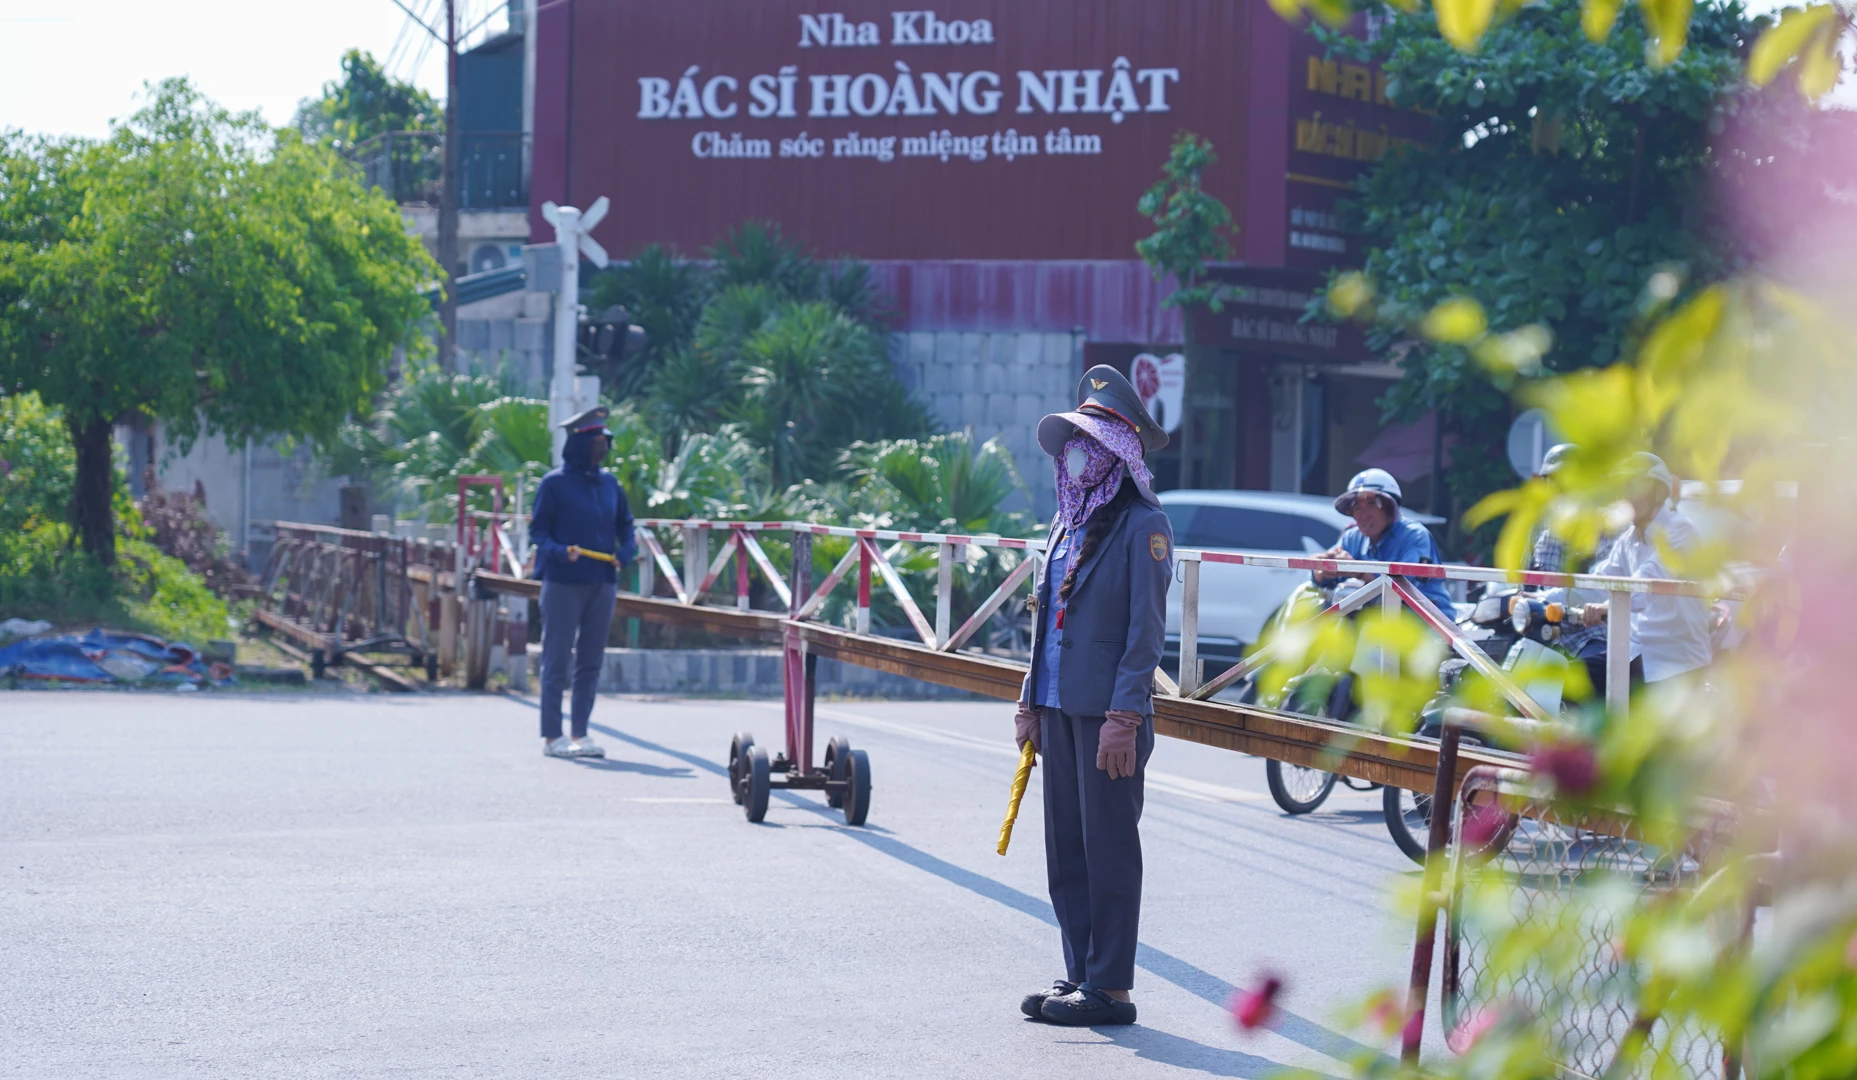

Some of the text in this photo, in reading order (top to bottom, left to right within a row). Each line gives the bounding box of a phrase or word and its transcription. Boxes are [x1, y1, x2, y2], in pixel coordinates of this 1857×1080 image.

[799, 10, 994, 47] Nha Khoa
[637, 56, 1179, 124] BÁC SĨ HOÀNG NHẬT
[692, 127, 1102, 162] Chăm sóc răng miệng tận tâm
